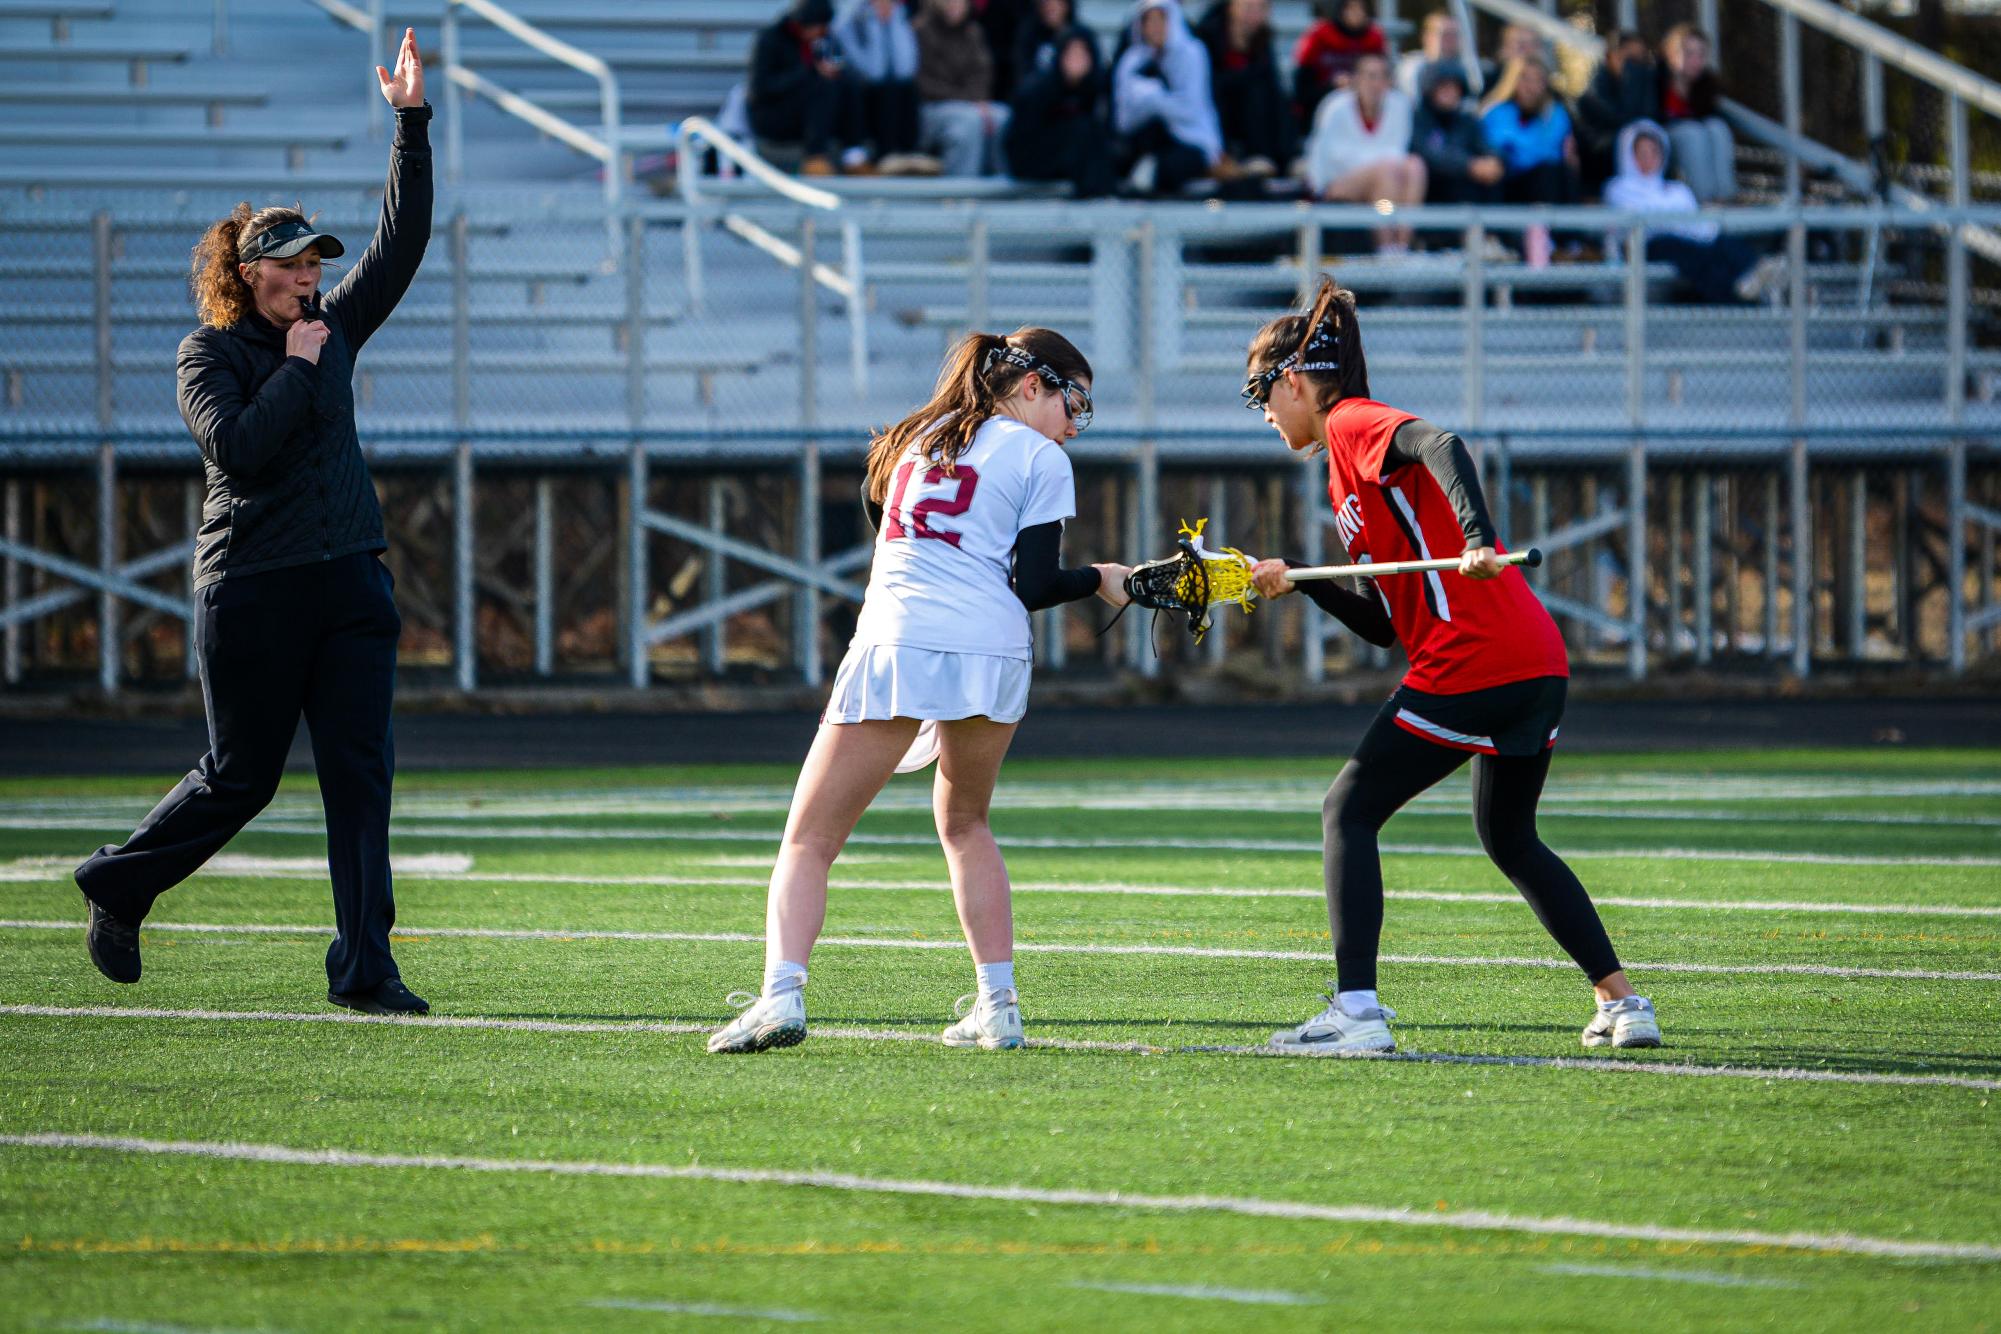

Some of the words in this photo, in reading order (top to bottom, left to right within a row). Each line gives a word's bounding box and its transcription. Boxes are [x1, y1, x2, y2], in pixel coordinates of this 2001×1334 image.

[1006, 354, 1030, 368] STX
[1011, 347, 1036, 362] STX
[886, 461, 979, 548] 12
